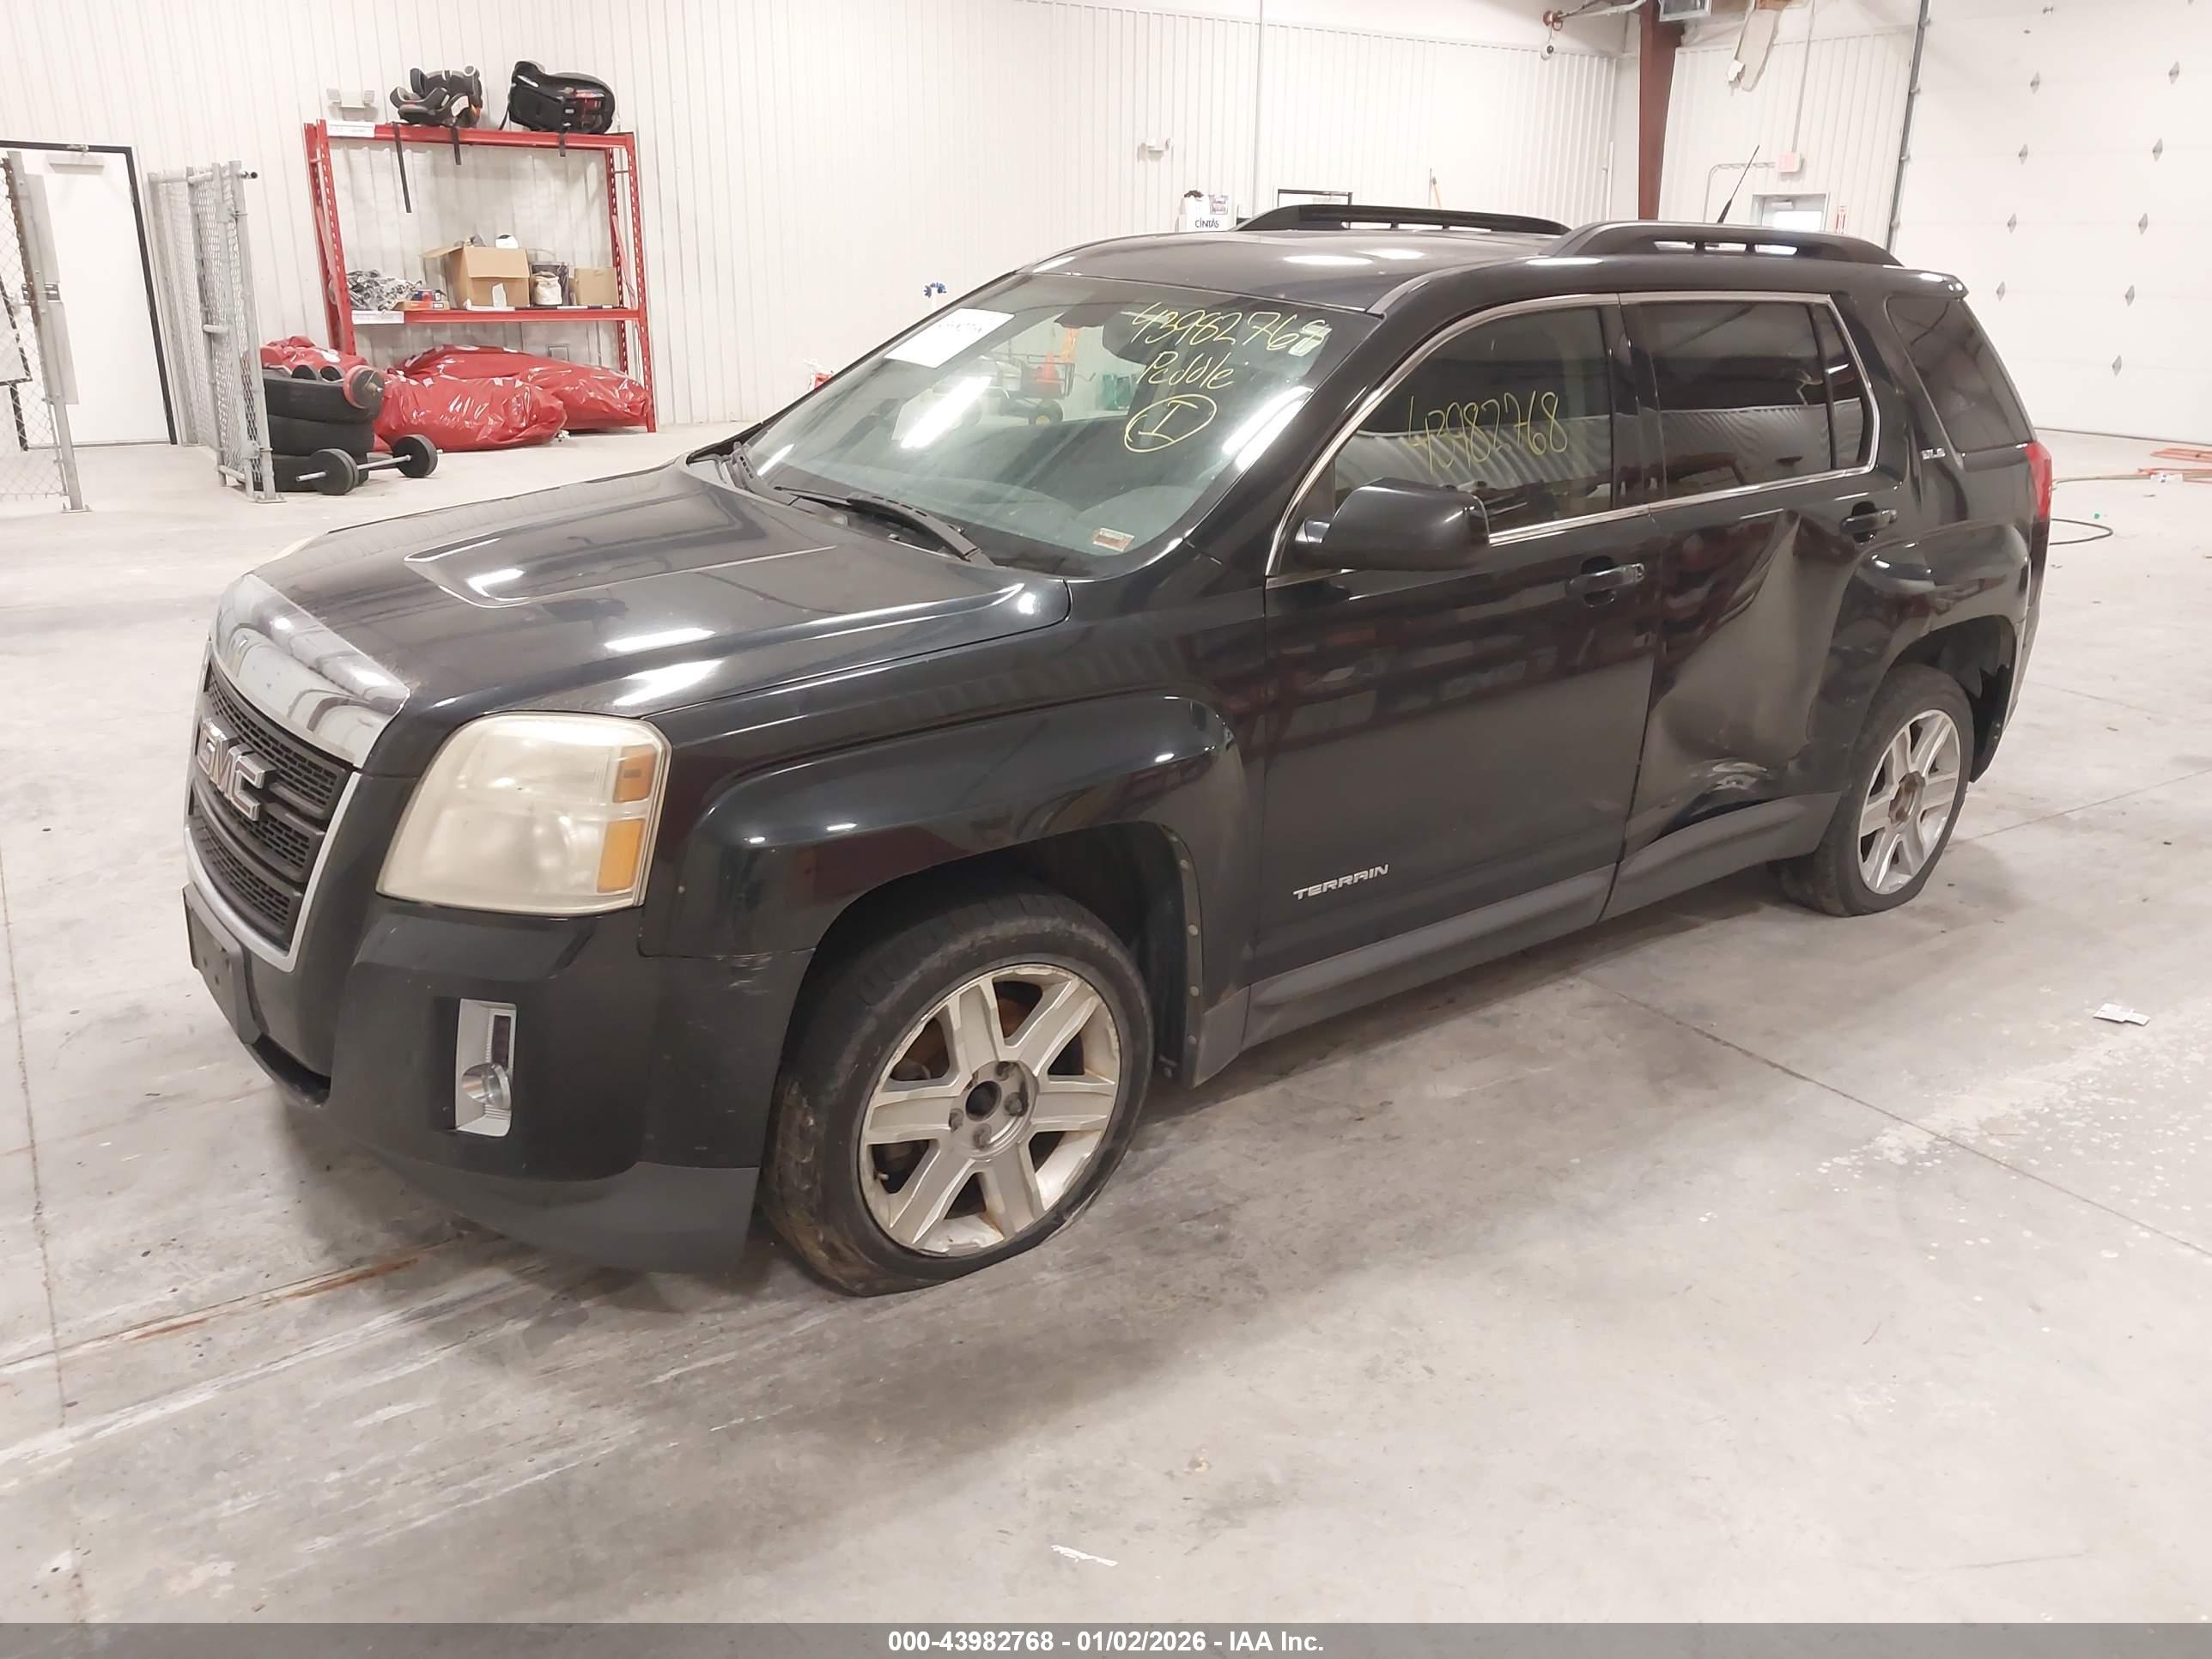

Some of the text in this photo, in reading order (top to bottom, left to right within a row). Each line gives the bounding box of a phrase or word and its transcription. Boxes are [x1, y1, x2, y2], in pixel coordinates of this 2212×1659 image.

[1194, 219, 1219, 228] CINTAS
[197, 718, 265, 822] GMC
[1292, 864, 1389, 900] TERRAIN
